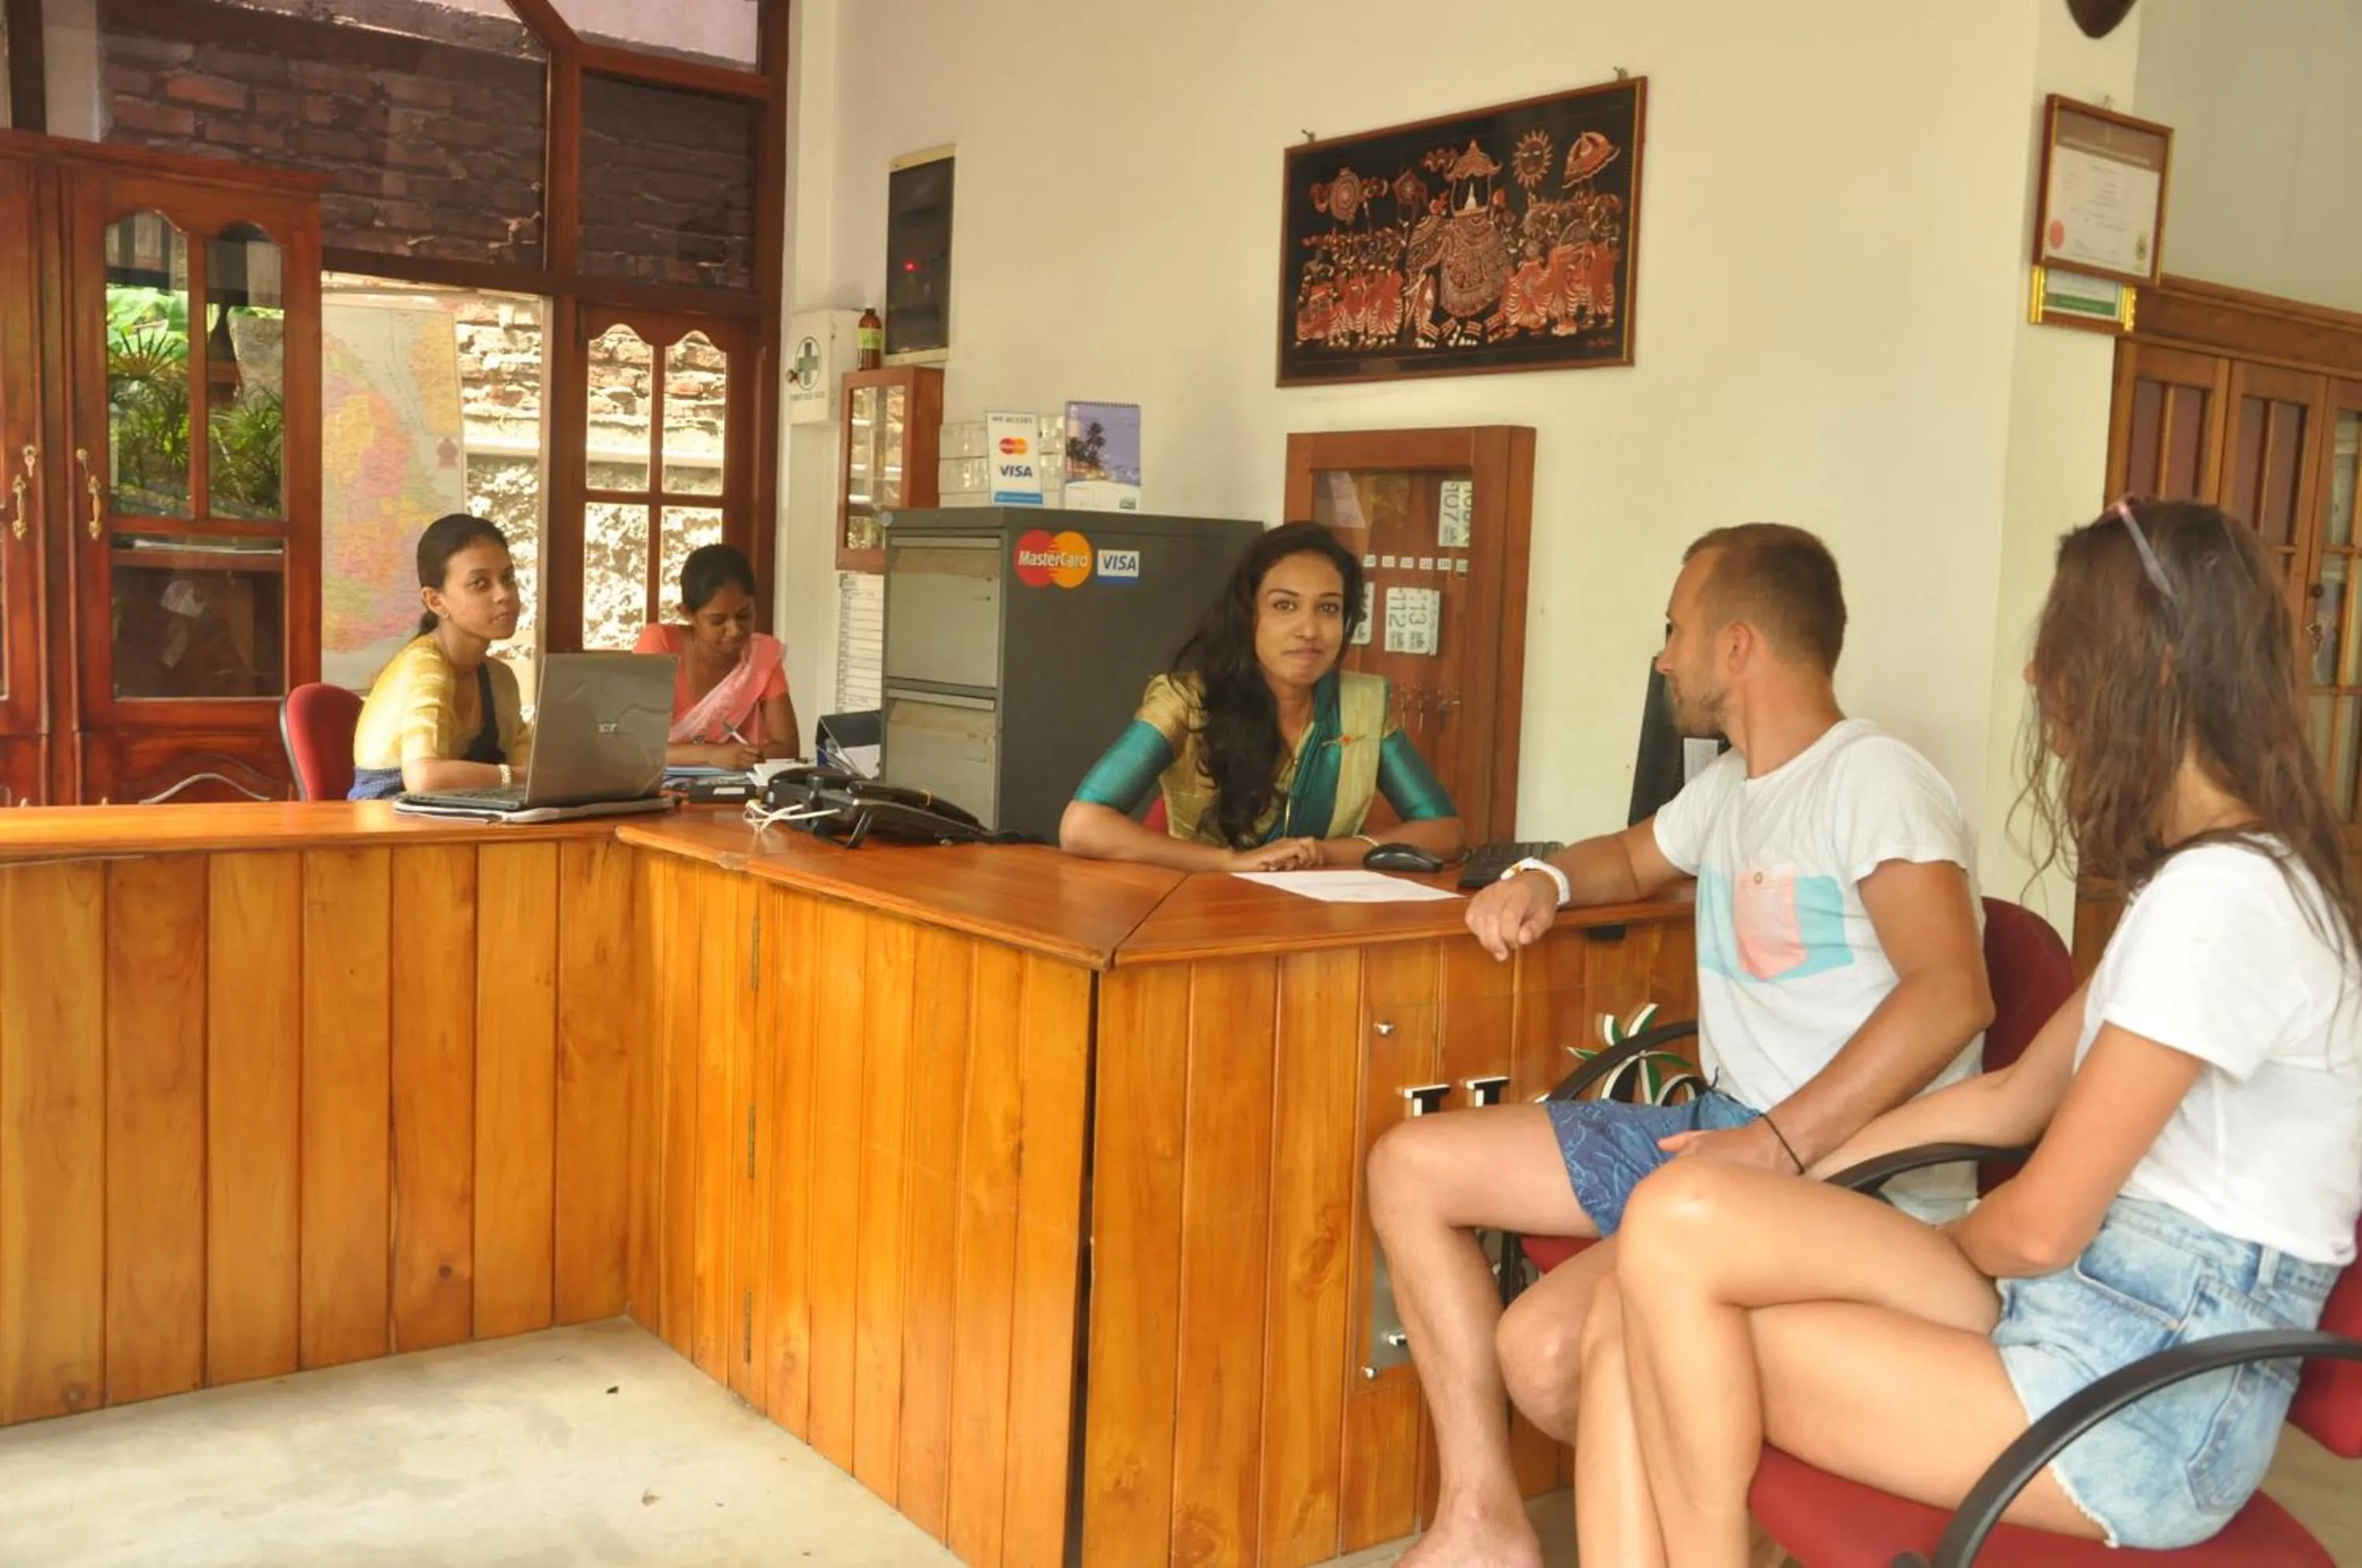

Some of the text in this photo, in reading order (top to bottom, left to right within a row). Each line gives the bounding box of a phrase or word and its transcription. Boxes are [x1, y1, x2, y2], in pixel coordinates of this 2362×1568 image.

[1001, 465, 1033, 478] VISA
[1442, 485, 1460, 521] 107
[1018, 550, 1087, 568] MasterCard
[1103, 554, 1136, 571] VISA
[1389, 595, 1407, 628] 112
